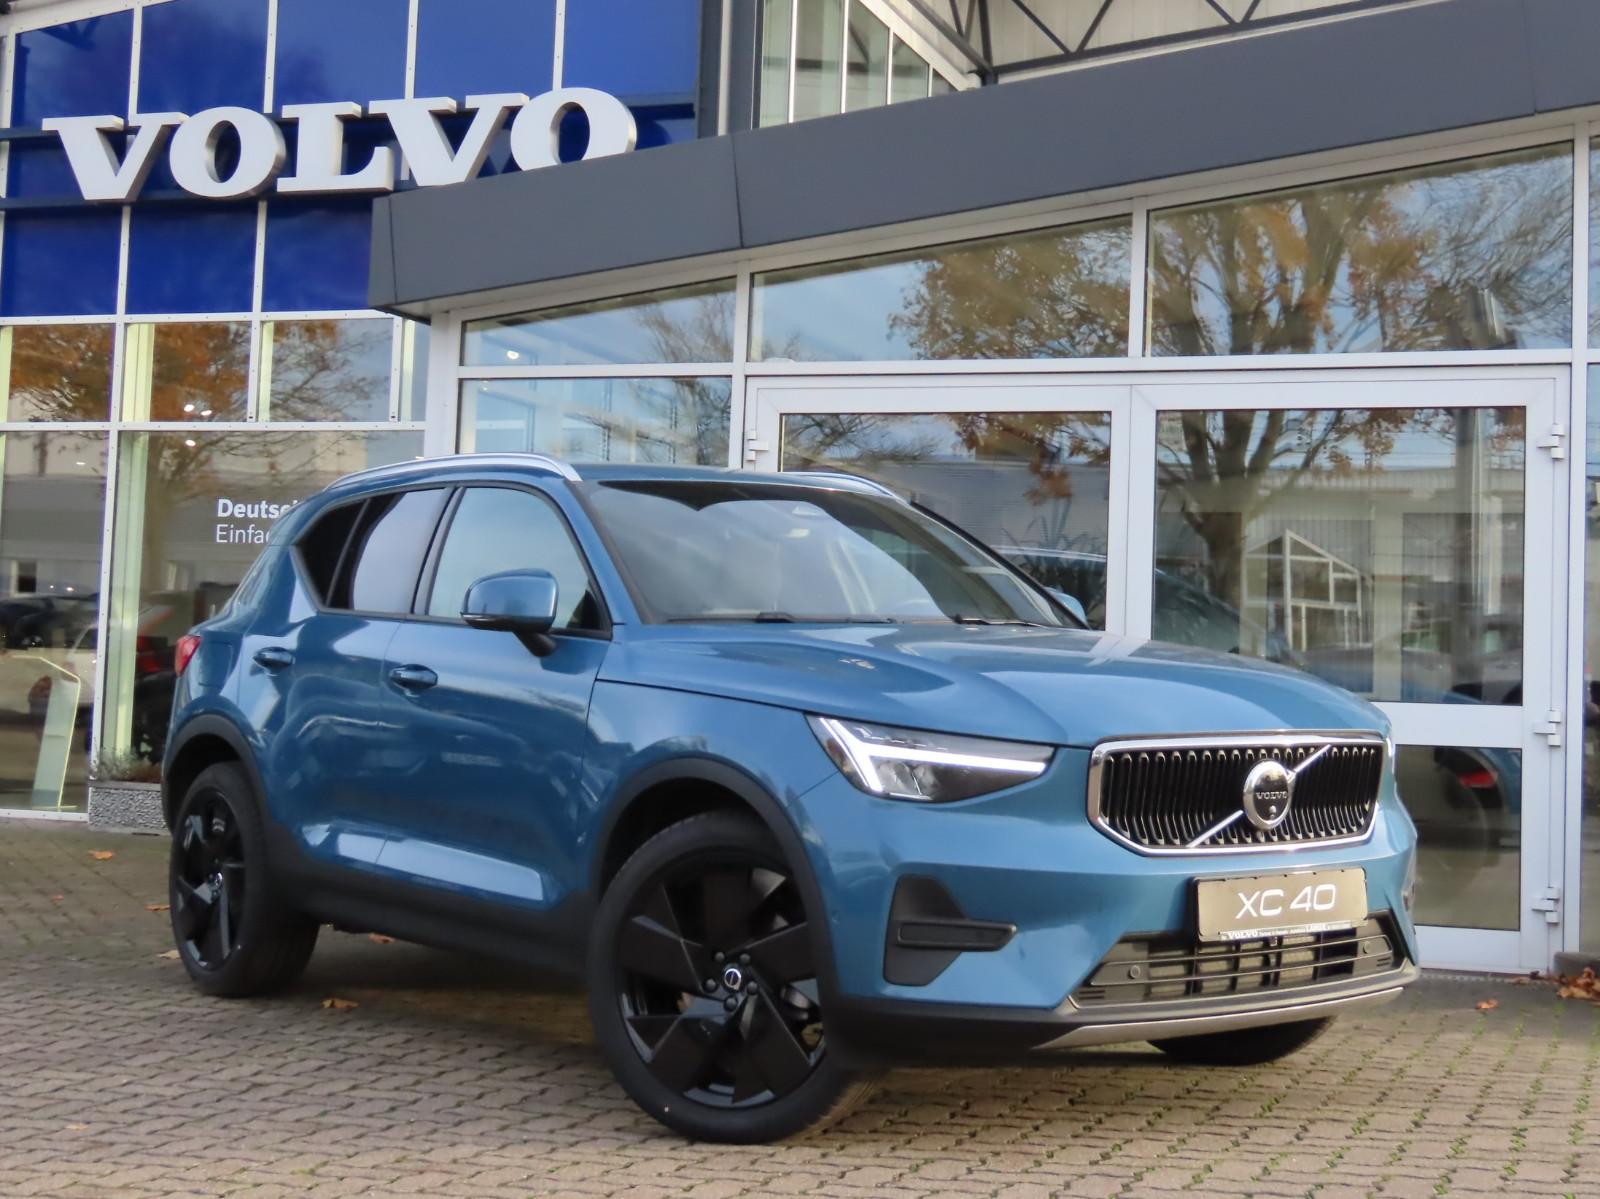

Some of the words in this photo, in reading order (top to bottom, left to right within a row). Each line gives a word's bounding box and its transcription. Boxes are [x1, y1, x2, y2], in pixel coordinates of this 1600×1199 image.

[41, 87, 637, 202] VOLVO
[217, 498, 299, 519] Deutsc
[1256, 791, 1288, 800] VOLVO
[1235, 888, 1285, 919] XC
[1289, 884, 1336, 912] 40
